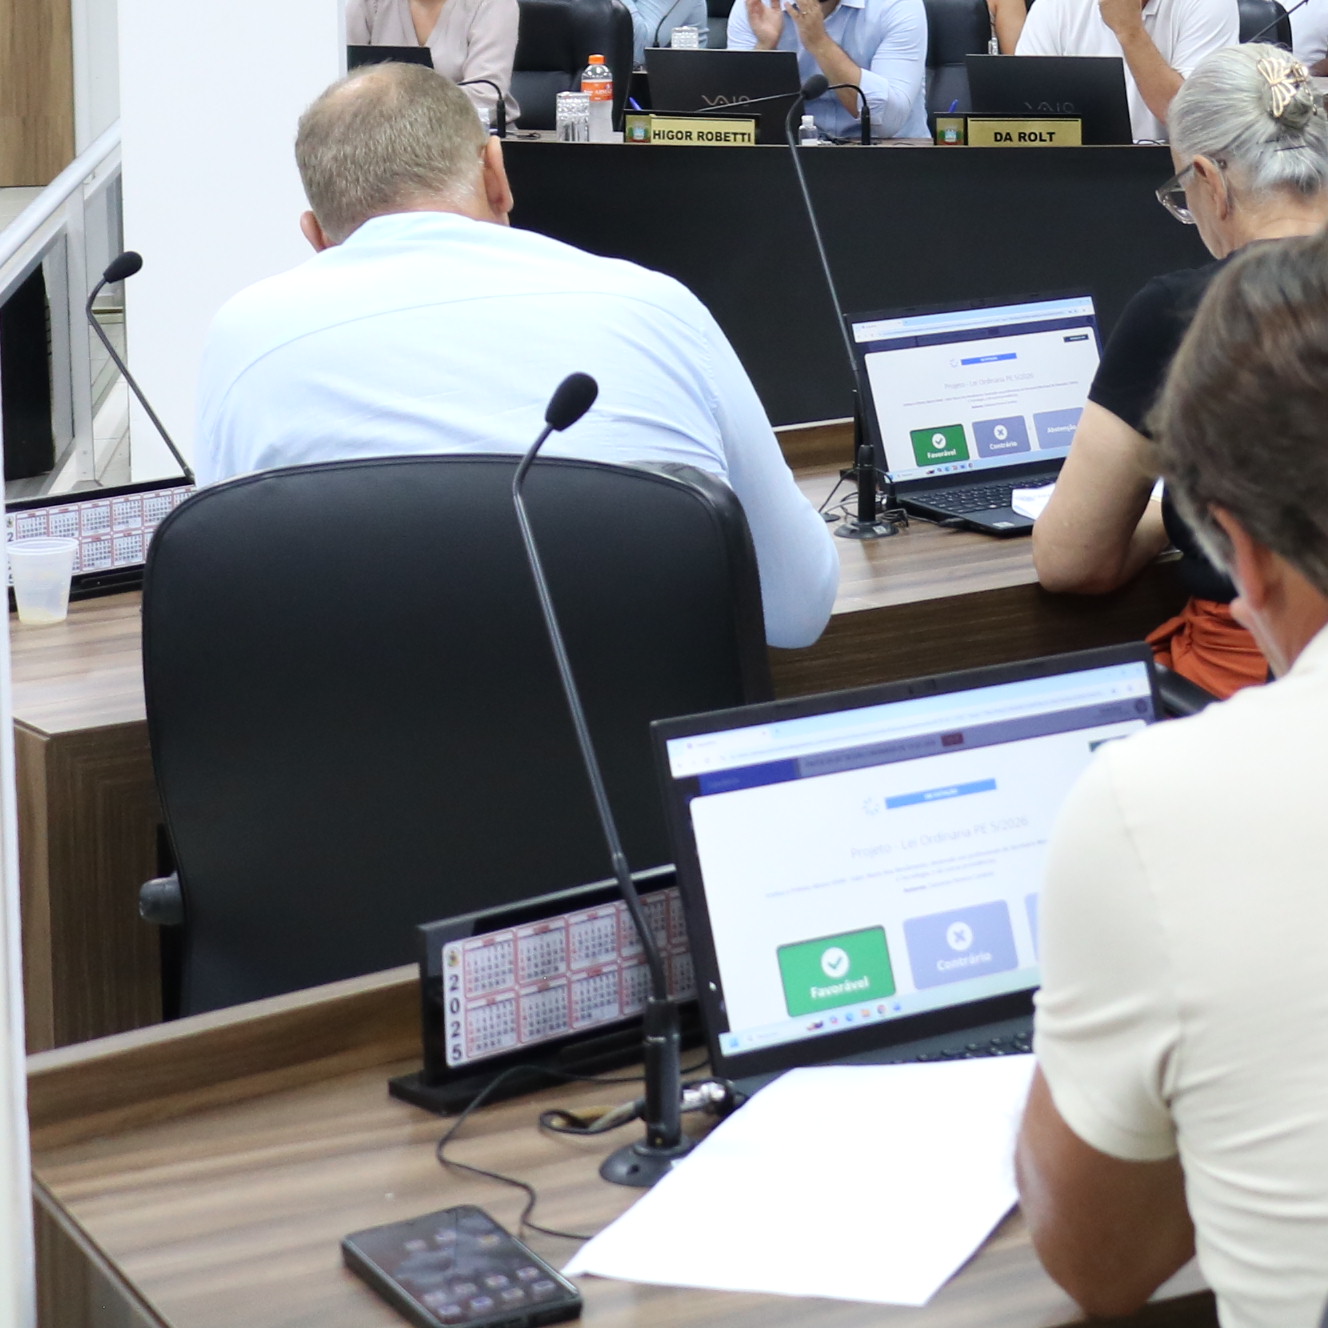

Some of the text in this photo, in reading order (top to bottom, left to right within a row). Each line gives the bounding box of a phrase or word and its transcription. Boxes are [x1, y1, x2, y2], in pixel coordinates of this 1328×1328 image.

[653, 129, 751, 143] HIGOR ROBETTI
[994, 132, 1055, 142] DA ROLT
[927, 448, 957, 460] Favorável
[990, 440, 1018, 451] Contrário
[810, 950, 992, 999] Favorável Contrário
[448, 974, 463, 1061] 2025
